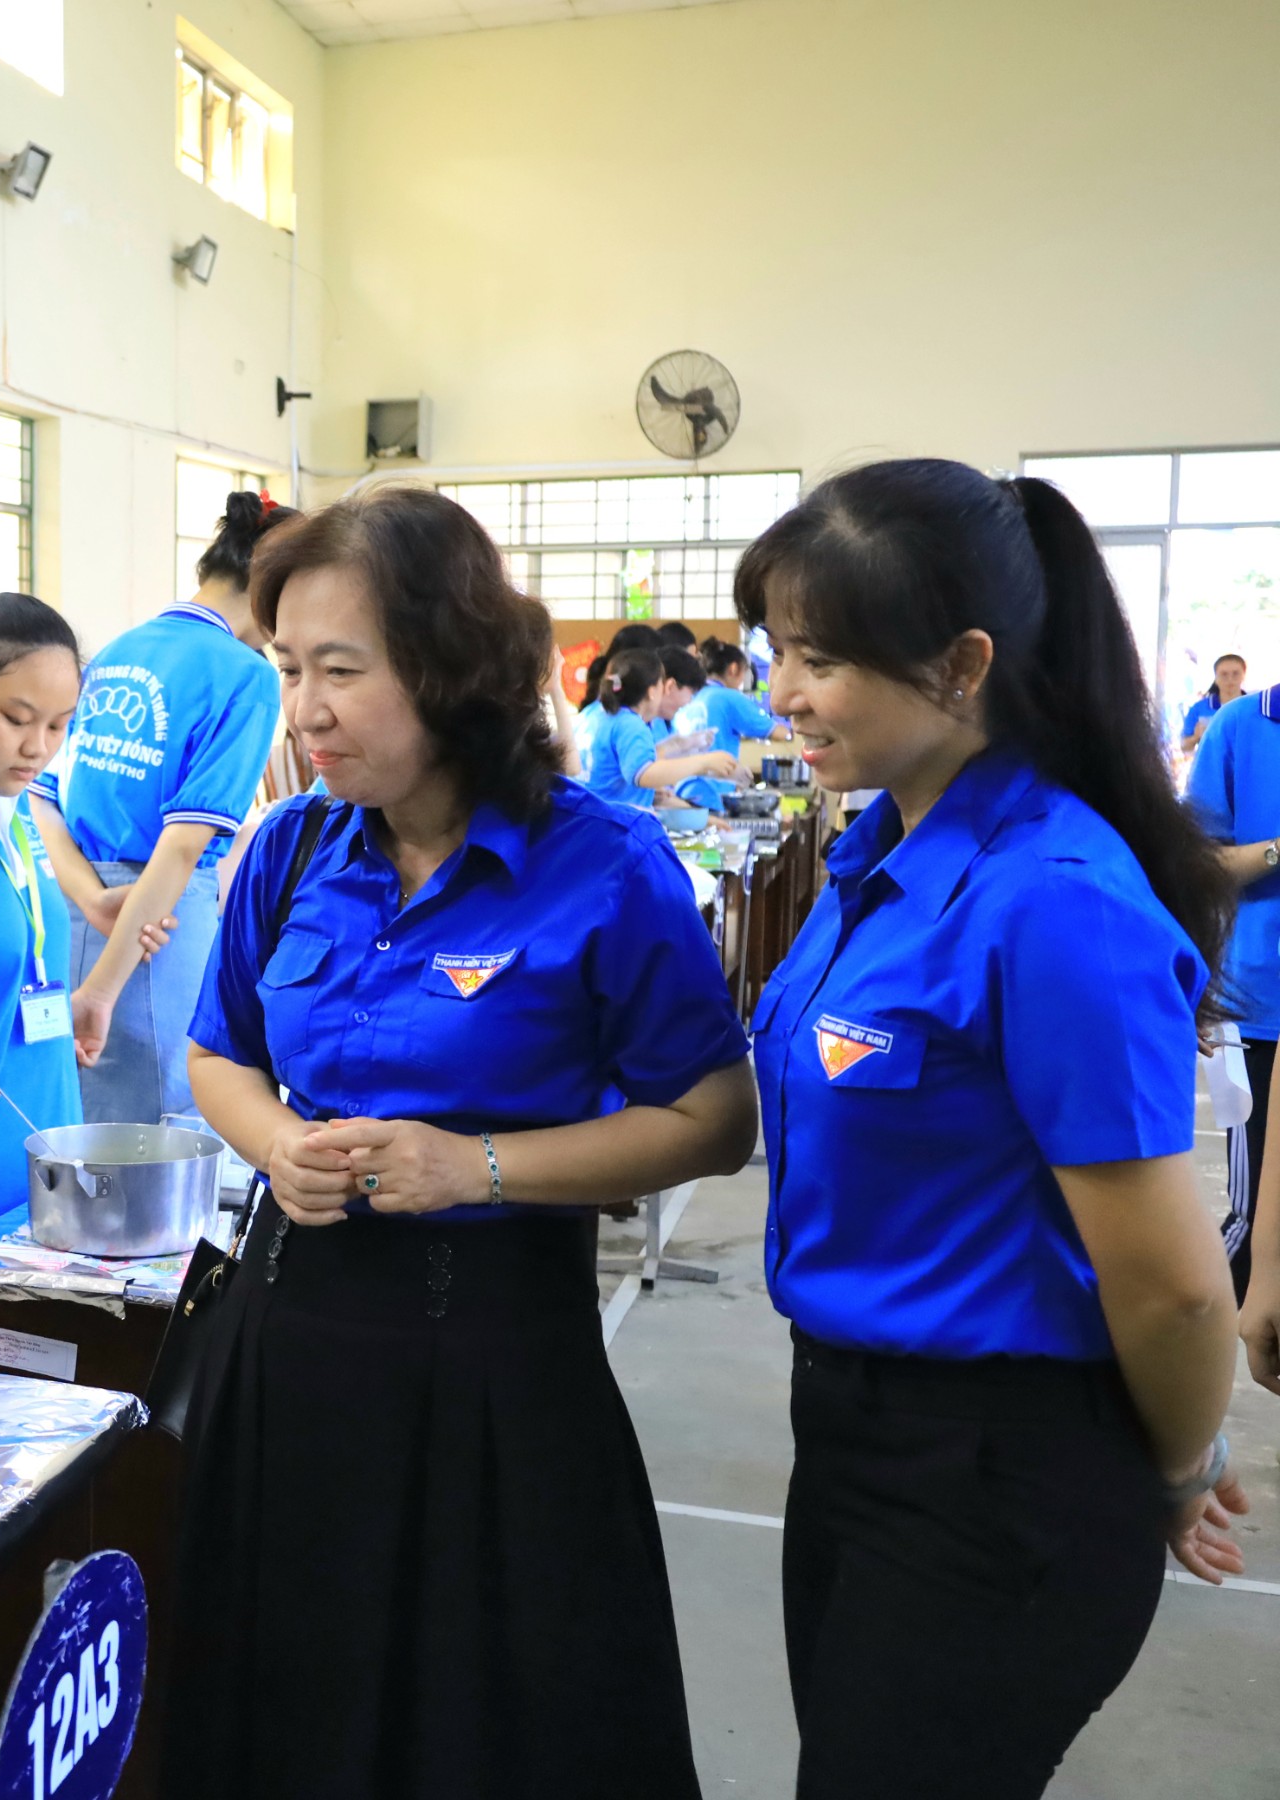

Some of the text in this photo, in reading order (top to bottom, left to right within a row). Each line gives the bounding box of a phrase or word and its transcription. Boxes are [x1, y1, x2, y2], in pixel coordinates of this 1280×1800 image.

[437, 958, 462, 967] THANH
[866, 1033, 887, 1047] NAM
[28, 1619, 120, 1800] 12A3
